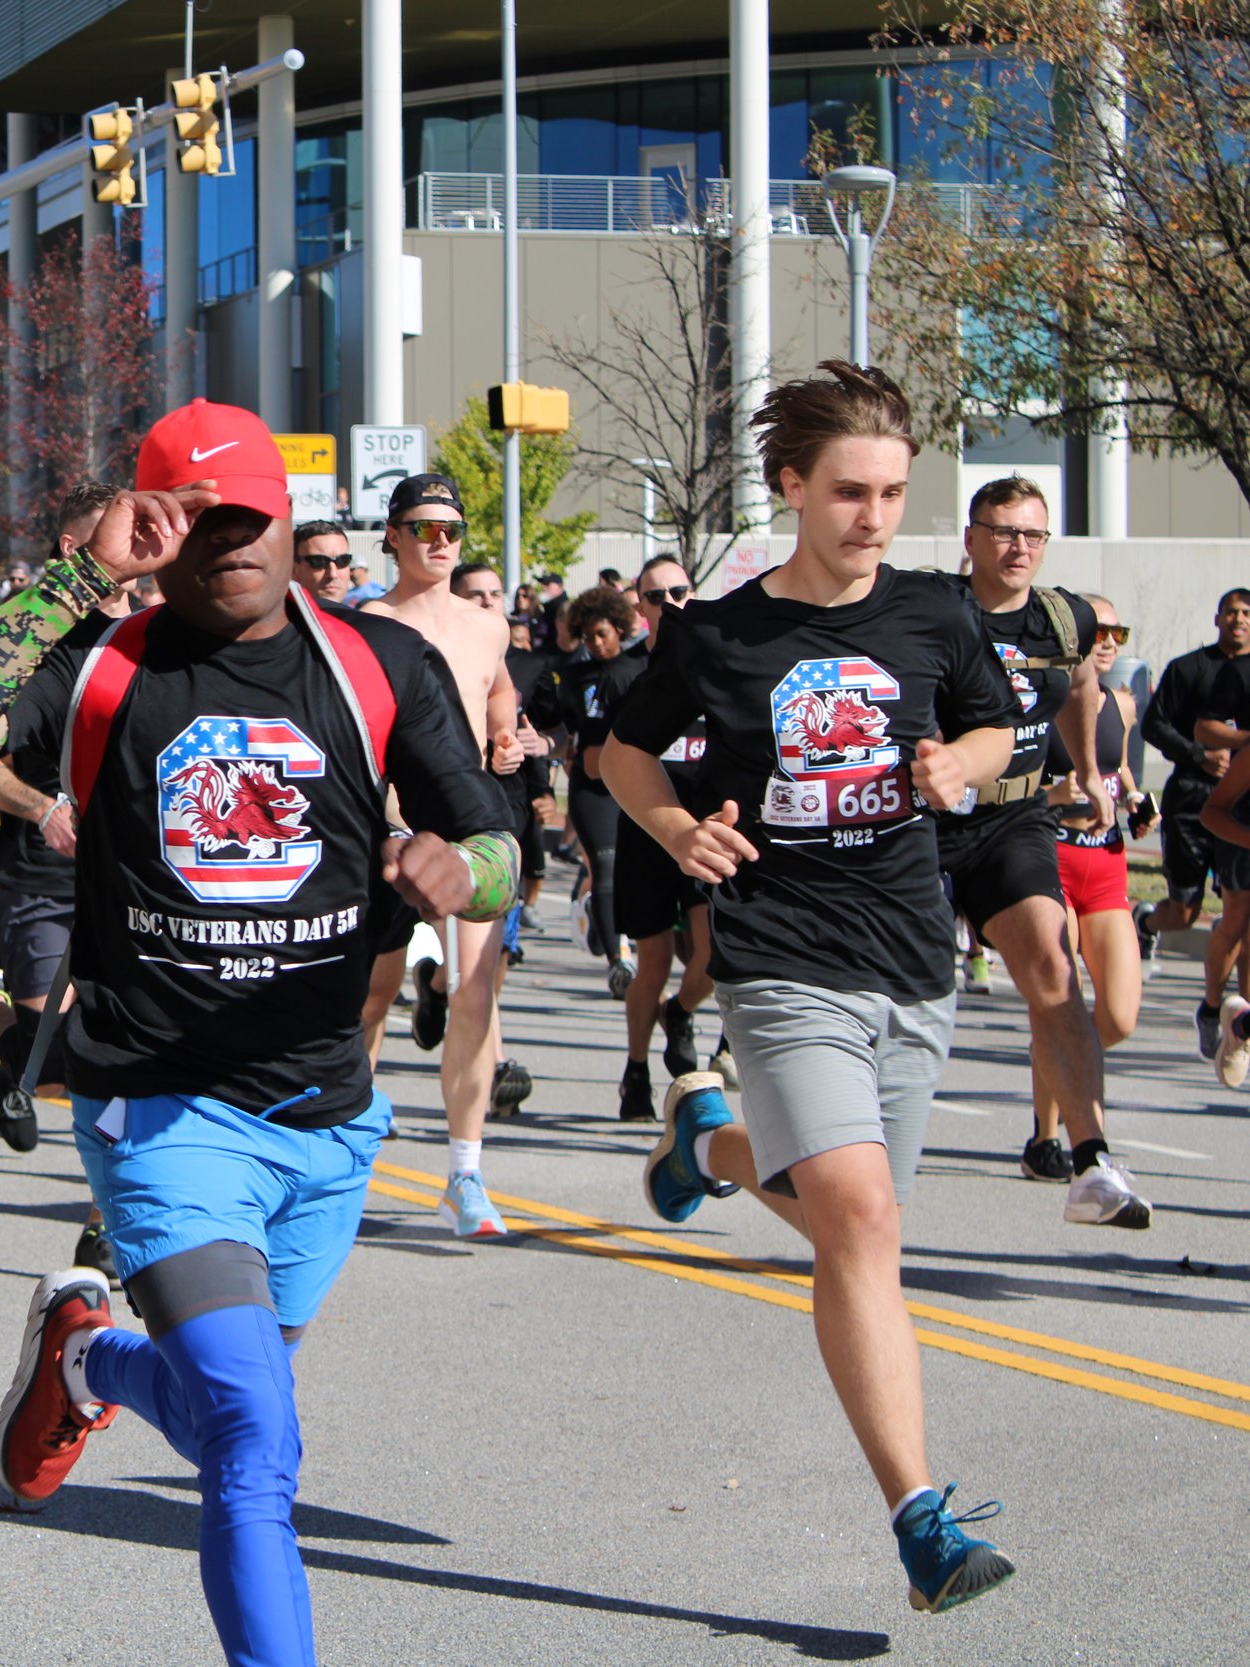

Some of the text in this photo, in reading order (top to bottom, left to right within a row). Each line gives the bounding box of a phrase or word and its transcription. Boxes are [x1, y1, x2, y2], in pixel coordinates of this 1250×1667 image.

[279, 443, 305, 452] NING
[364, 434, 414, 451] STOP
[373, 454, 405, 465] HERE
[1016, 724, 1036, 741] DAY
[838, 778, 900, 817] 665
[832, 828, 874, 848] 2022
[127, 906, 359, 945] USC VETERANS DAY 5K
[219, 956, 276, 980] 2022
